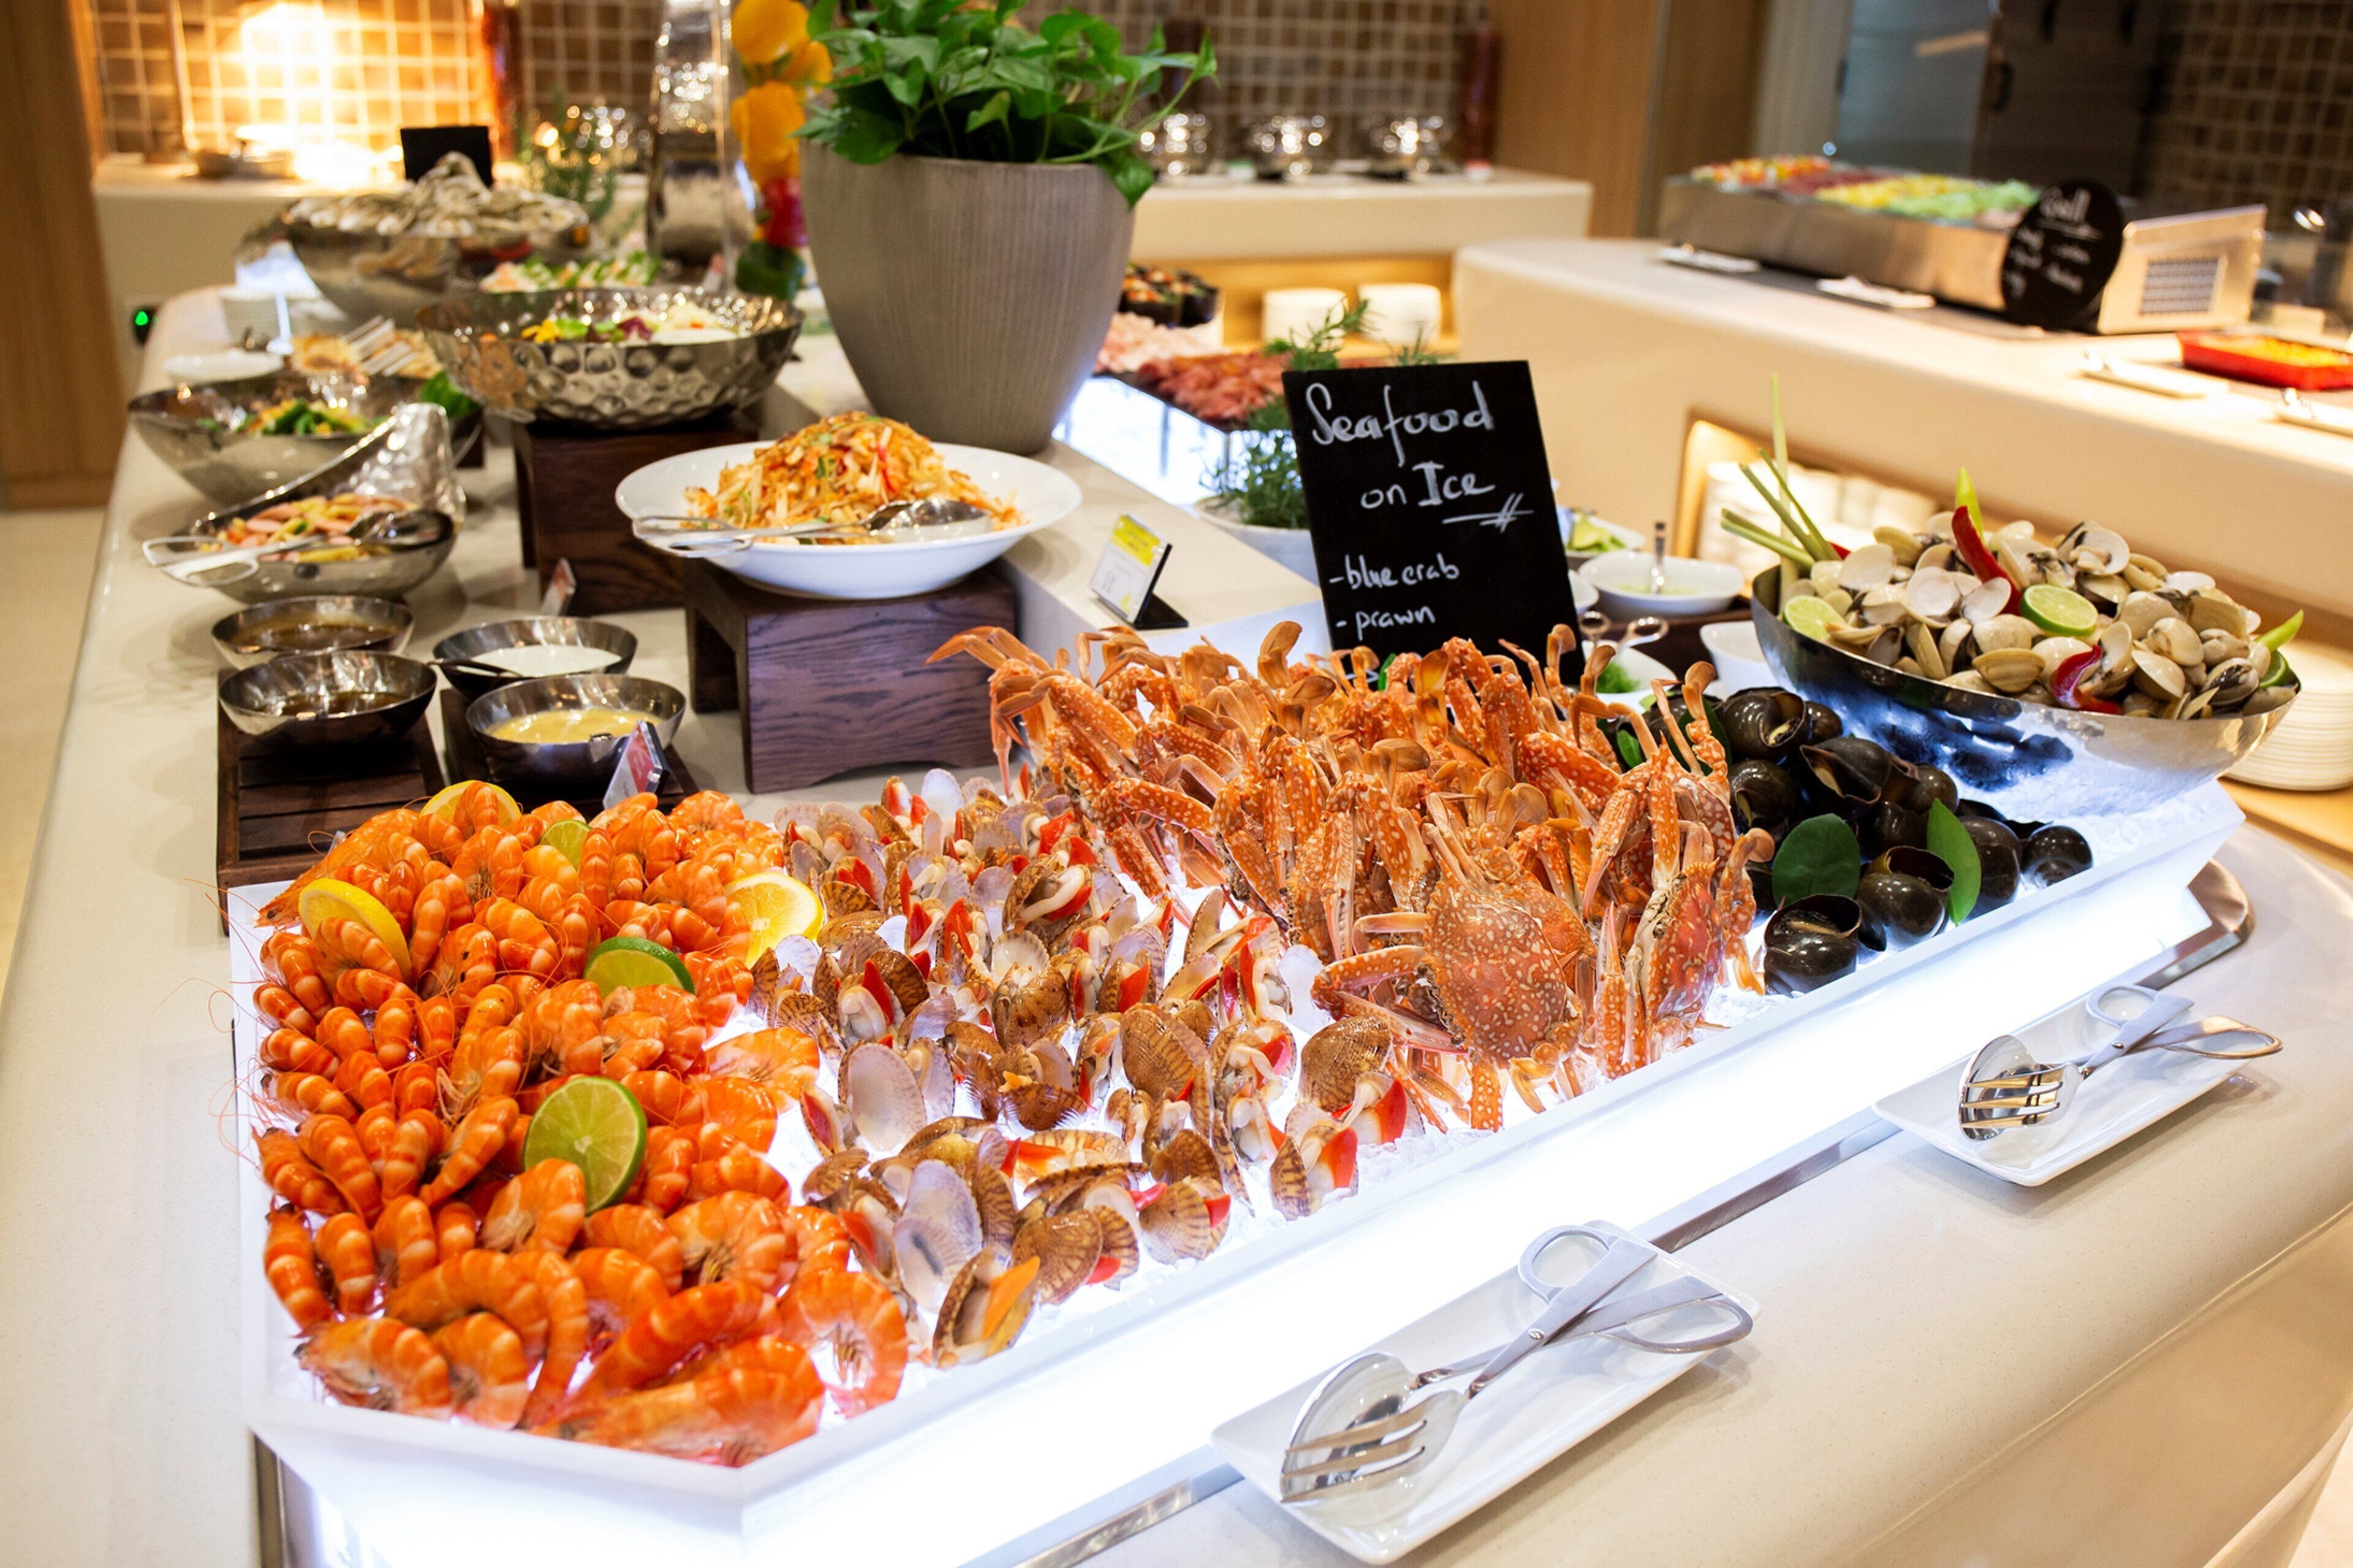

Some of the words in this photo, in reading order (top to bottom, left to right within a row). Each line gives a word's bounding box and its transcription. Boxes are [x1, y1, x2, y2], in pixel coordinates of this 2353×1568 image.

[1306, 381, 1495, 467] Seafood
[1360, 483, 1408, 509] on
[1412, 461, 1495, 507] Ice
[1401, 553, 1460, 585] crab
[1355, 606, 1436, 641] prawn
